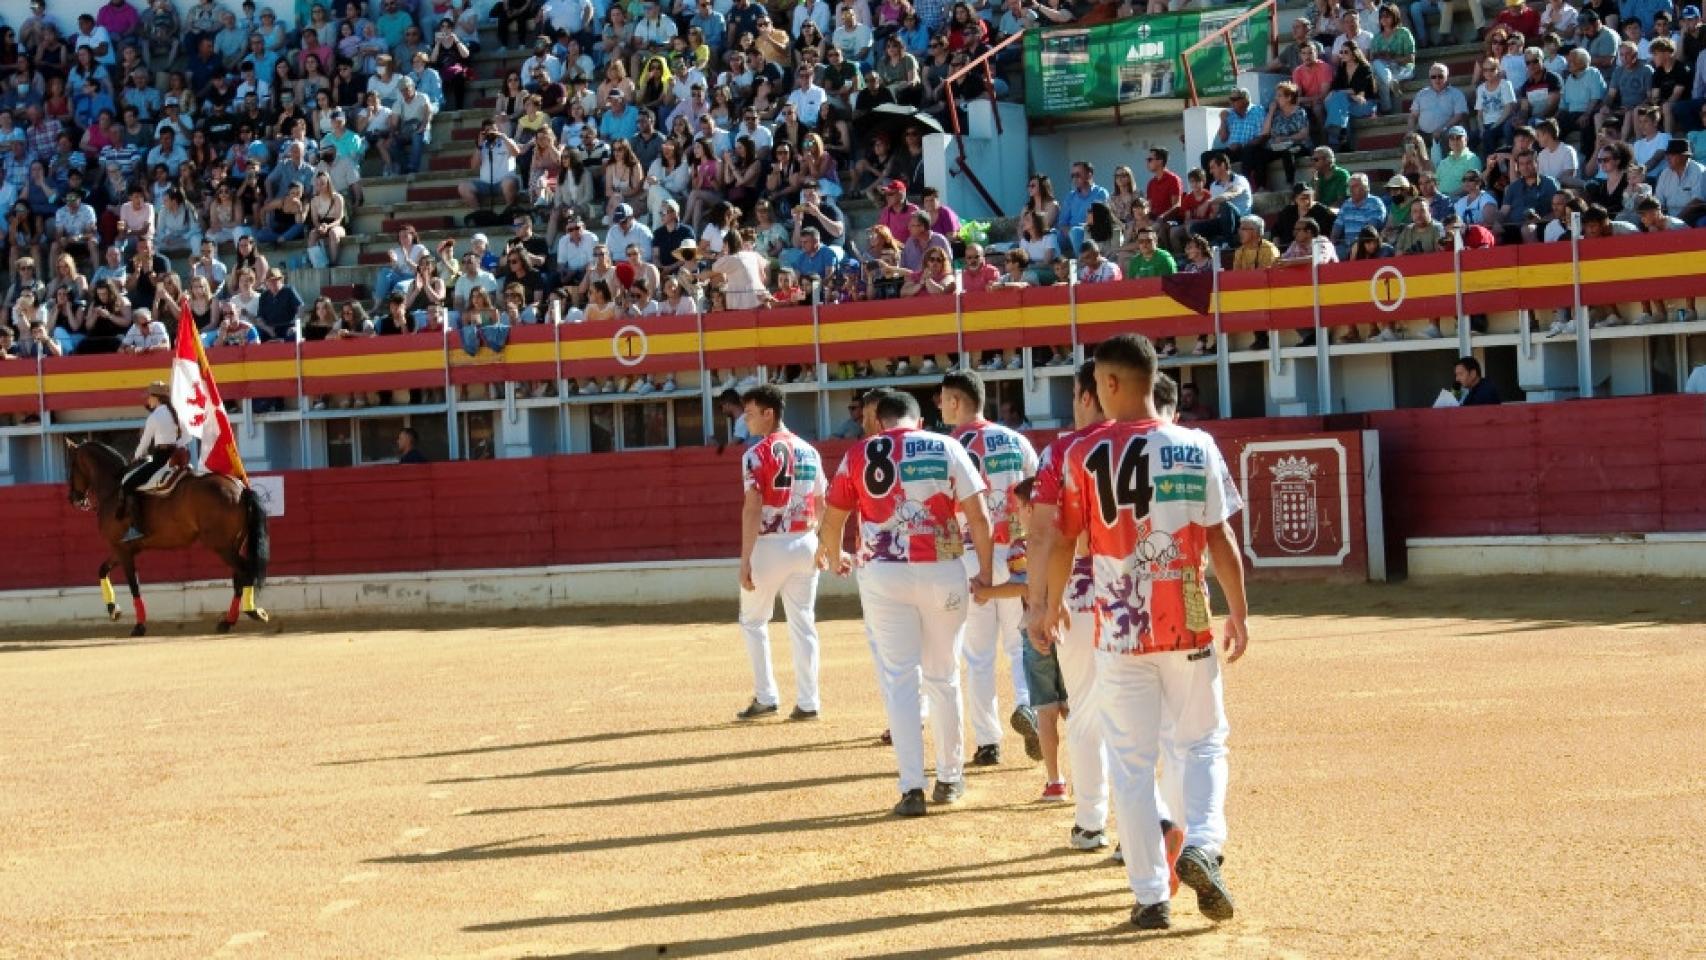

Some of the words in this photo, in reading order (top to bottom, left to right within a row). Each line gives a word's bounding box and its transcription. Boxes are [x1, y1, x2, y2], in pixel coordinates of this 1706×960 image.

[772, 441, 792, 488] 2
[863, 437, 896, 496] 8
[905, 439, 945, 457] gaza
[1160, 444, 1205, 470] gaza
[1085, 436, 1154, 525] 14
